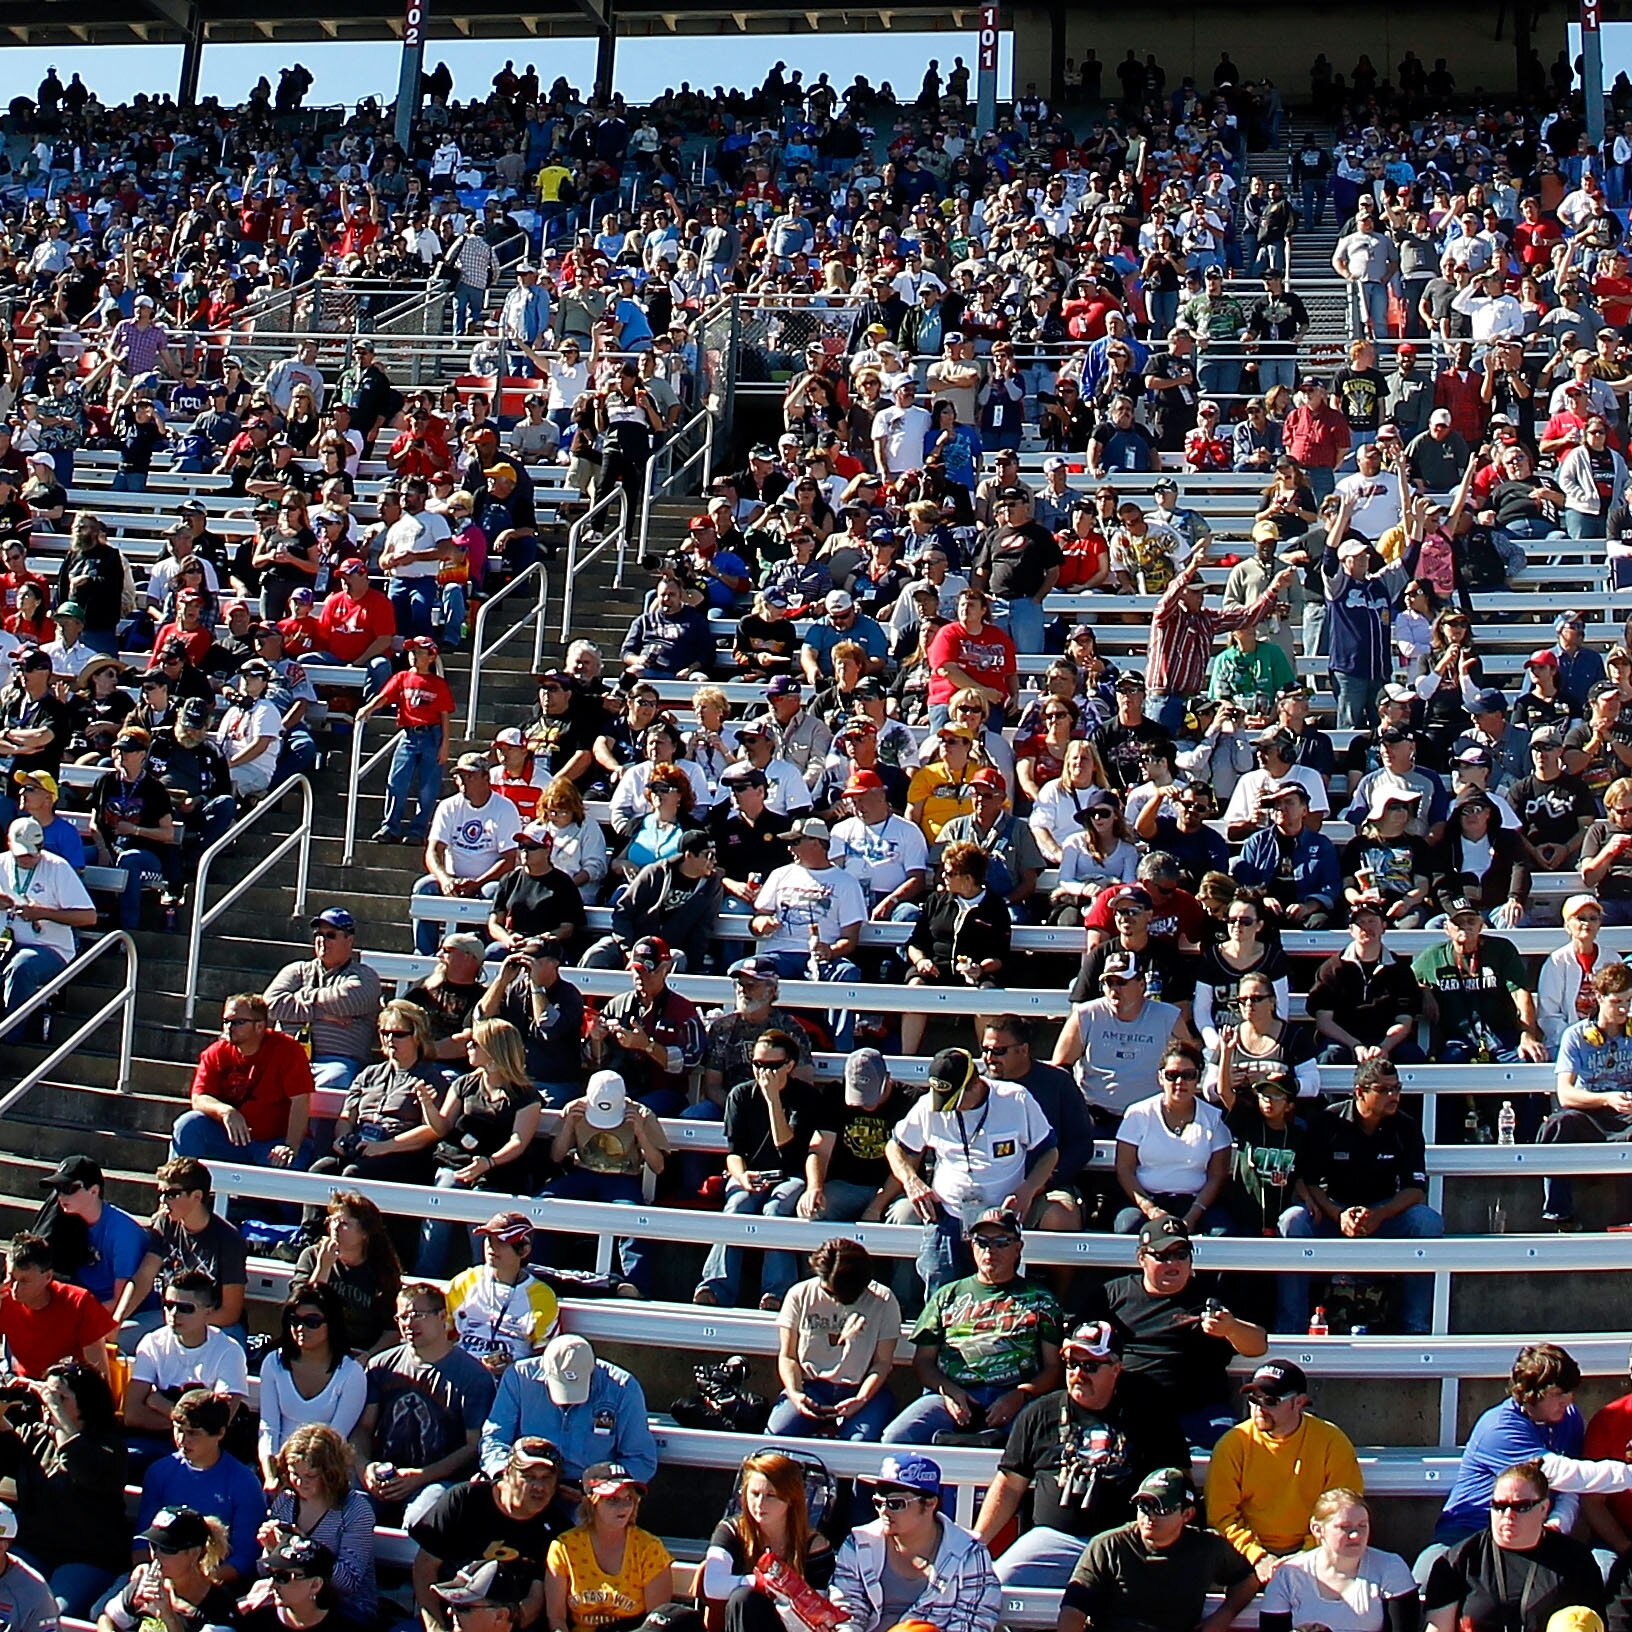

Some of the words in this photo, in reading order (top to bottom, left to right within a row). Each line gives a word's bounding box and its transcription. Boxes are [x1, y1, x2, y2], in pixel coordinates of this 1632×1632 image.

[981, 9, 995, 68] 101
[179, 396, 202, 410] TCU
[1525, 791, 1576, 818] OAKLEY
[1102, 1031, 1154, 1044] AMERICA
[997, 1142, 1010, 1156] 24
[483, 1540, 520, 1561] 6
[612, 1594, 637, 1612] WIN
